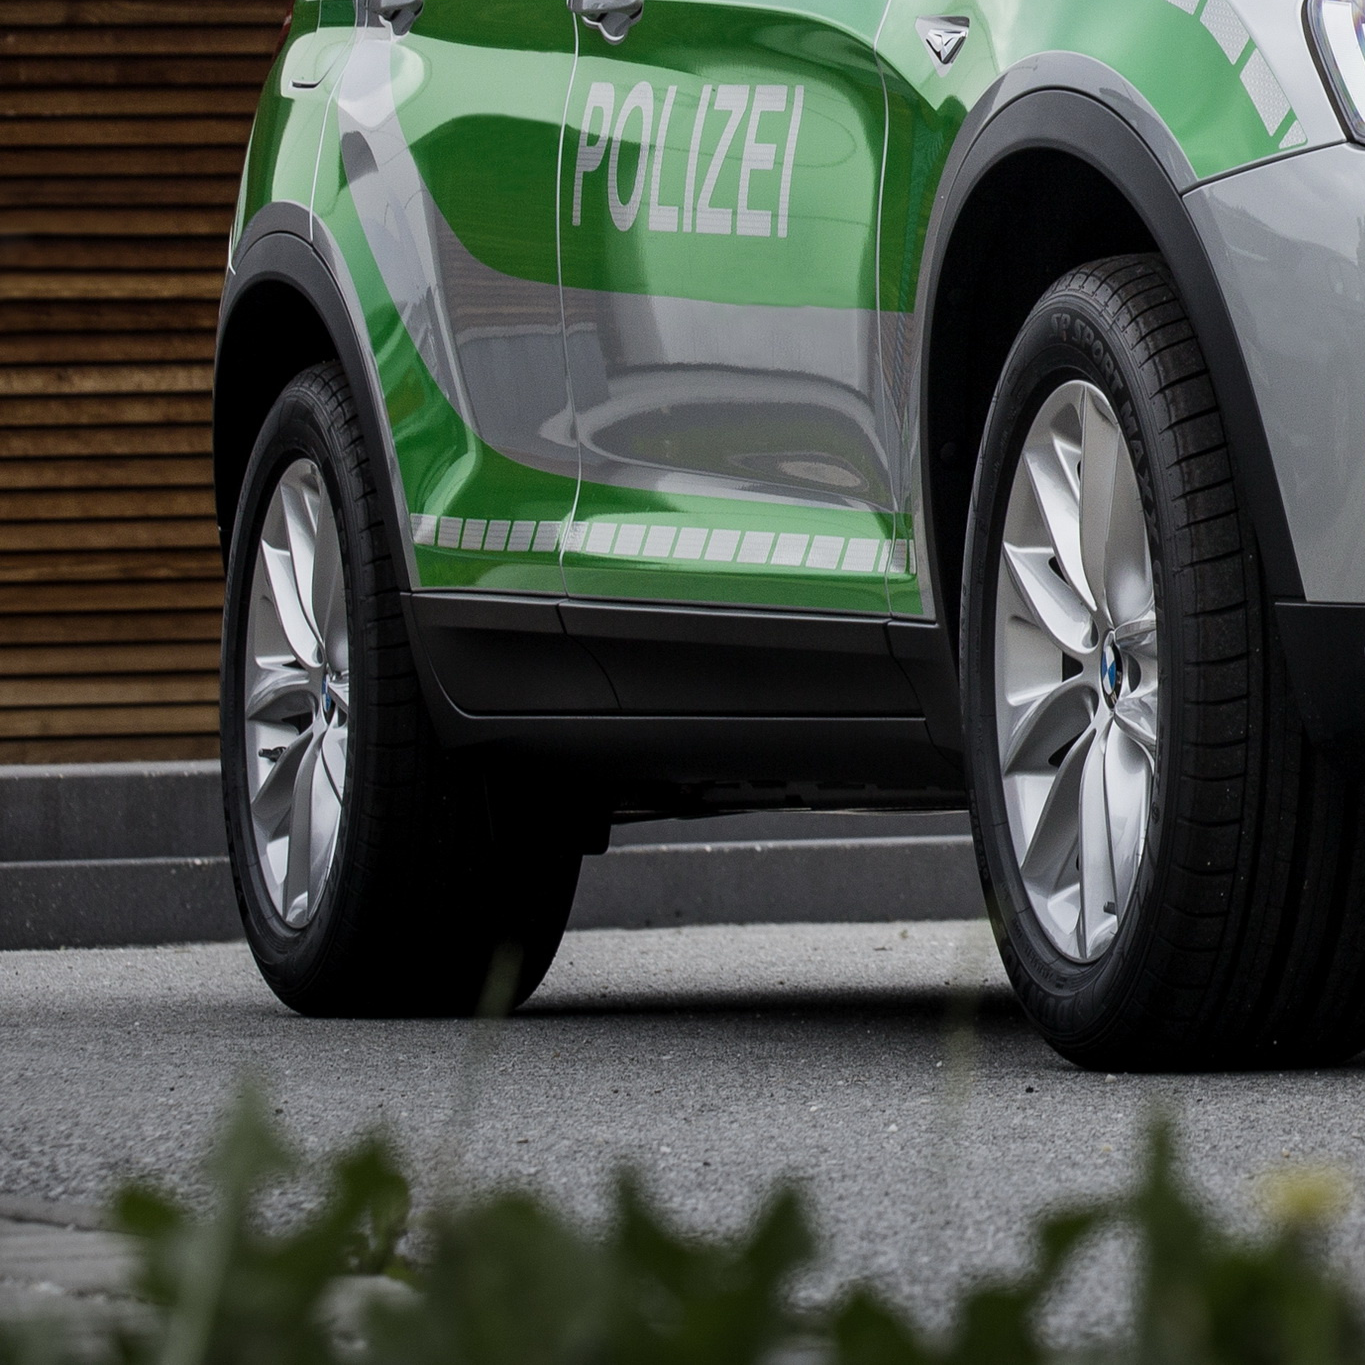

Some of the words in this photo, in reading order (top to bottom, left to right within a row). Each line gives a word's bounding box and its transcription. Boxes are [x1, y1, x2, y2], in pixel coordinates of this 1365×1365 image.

[572, 81, 804, 238] POLIZEI
[1050, 313, 1071, 343] SP
[1072, 317, 1124, 397] SPORT
